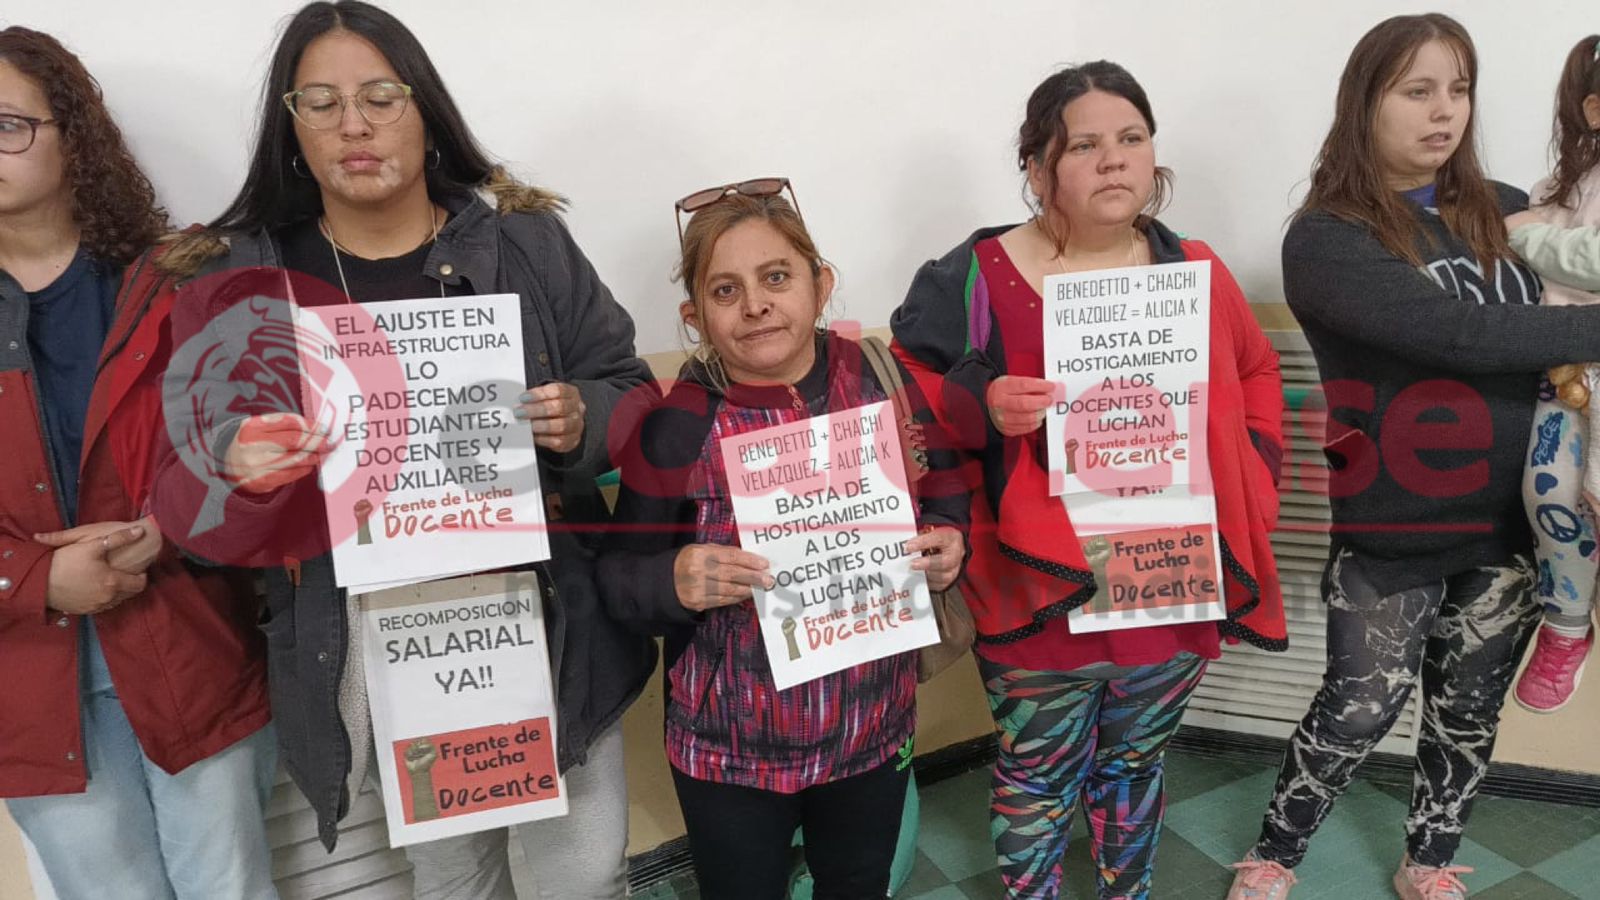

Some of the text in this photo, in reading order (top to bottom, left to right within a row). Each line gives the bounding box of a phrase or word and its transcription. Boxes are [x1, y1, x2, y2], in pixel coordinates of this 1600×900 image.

[1057, 271, 1196, 300] BENEDETTO + CHACHI
[335, 307, 495, 336] EL AJUSTE EN
[1055, 304, 1127, 327] VELAZQUEZ
[1145, 299, 1186, 319] ALICIA
[1191, 297, 1198, 315] K
[323, 333, 510, 360] INFRAESTRUCTURA
[1082, 329, 1173, 351] BASTA DE
[405, 361, 438, 381] LO
[1057, 348, 1197, 374] HOSTIGAMIENTO
[1101, 373, 1155, 391] A LOS
[349, 384, 497, 413] PADECEMOS
[1056, 390, 1199, 415] DOCENTES QUE
[344, 410, 508, 442] ESTUDIANTES,
[1087, 414, 1166, 434] LUCHAN
[355, 437, 502, 467] DOCENTES Y
[738, 414, 884, 464] BENEDETTO + CHACHI
[1085, 430, 1188, 451] Frente de Lucha
[741, 458, 820, 493] VELAZQUEZ
[838, 444, 879, 471] ALICIA
[881, 442, 891, 460] K
[1086, 443, 1187, 470] Docente
[365, 464, 498, 494] AUXILIARES
[383, 485, 513, 514] Frente de Lucha
[776, 478, 872, 515] BASTA DE
[385, 501, 514, 538] Docente
[754, 495, 900, 544] HOSTIGAMIENTO
[805, 528, 861, 556] A LOS
[871, 540, 912, 566] QUE
[1114, 531, 1204, 558] Frente de
[1133, 552, 1190, 572] Lucha
[800, 572, 884, 608] LUCHAN
[1112, 574, 1216, 603] Docente
[379, 598, 531, 632] RECOMPOSICION
[803, 588, 910, 629] Frente de Lucha
[806, 605, 914, 650] Docente
[386, 623, 534, 664] SALARIAL
[435, 665, 494, 694] YA!!
[440, 727, 540, 760] Frente de
[463, 749, 526, 774] Lucha
[439, 771, 555, 810] Docente
